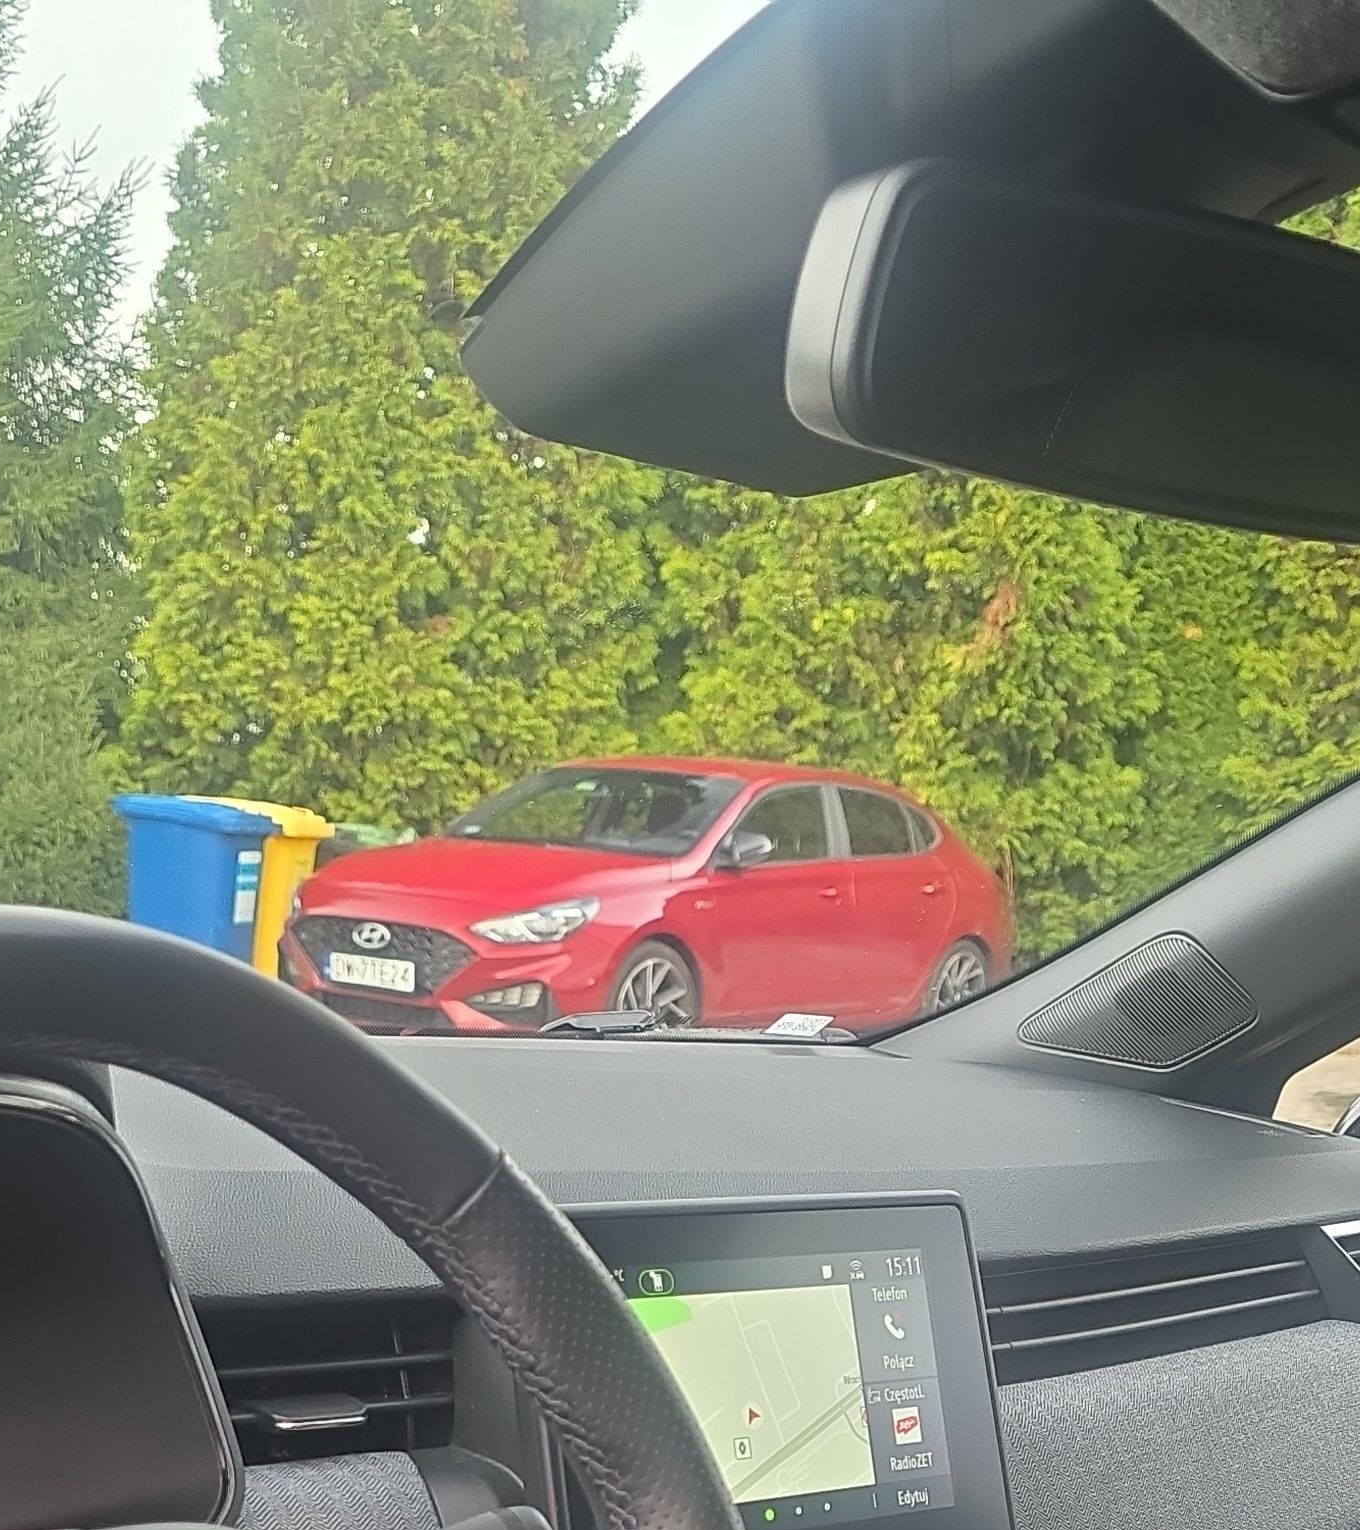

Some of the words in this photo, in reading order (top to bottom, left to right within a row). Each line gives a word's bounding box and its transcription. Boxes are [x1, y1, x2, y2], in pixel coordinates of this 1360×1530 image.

[885, 1256, 921, 1277] 15:11
[871, 1286, 908, 1302] Telefon
[898, 1488, 929, 1507] Edytuj
